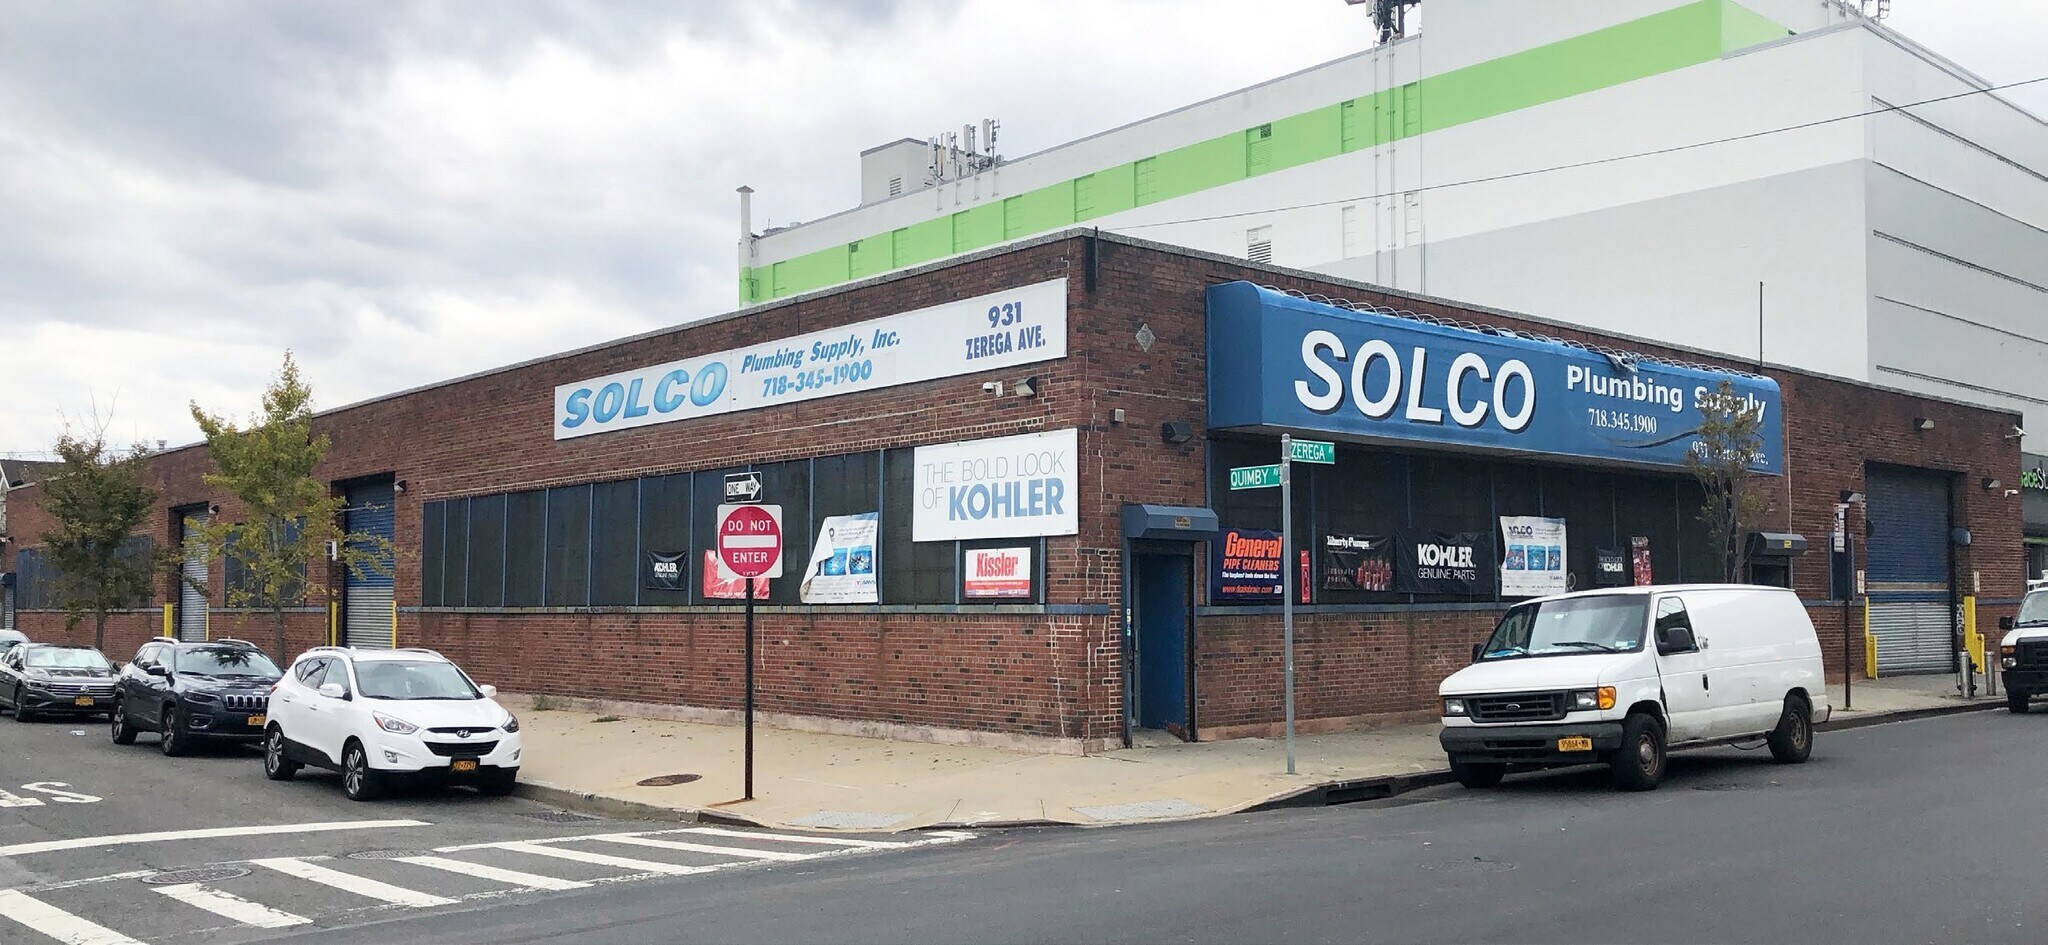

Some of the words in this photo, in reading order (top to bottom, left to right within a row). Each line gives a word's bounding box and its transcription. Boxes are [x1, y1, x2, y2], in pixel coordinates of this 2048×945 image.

[988, 301, 1023, 328] 931
[741, 347, 804, 374] Plumbing
[810, 334, 866, 363] Supply,
[871, 327, 901, 349] Inc.
[965, 332, 1015, 360] ZEREGA
[1018, 326, 1047, 351] AVE.
[763, 359, 873, 397] 718-345-1900
[1294, 329, 1536, 432] SOLCO
[1566, 364, 1684, 413] Plumbing
[561, 361, 729, 429] SOLCO
[1588, 408, 1658, 435] 718.345.1900
[1291, 443, 1326, 461] ZEREGA
[1692, 441, 1708, 458] 931
[923, 461, 955, 485] THE
[962, 456, 1009, 482] BOLD
[1017, 450, 1066, 477] LOOK
[1230, 469, 1269, 487] QUIMBY
[728, 483, 739, 494] ONE
[745, 481, 757, 493] WAY
[922, 487, 944, 510] OF
[949, 478, 1065, 521] KOHLER
[728, 520, 743, 532] DO
[750, 520, 772, 532] NOT
[732, 552, 768, 563] ENTER
[1225, 531, 1283, 558] General
[976, 553, 1019, 578] Kissler
[1223, 558, 1241, 570] PIPE
[1242, 559, 1280, 571] CLEANERS
[1417, 569, 1452, 579] GENUINE
[1453, 569, 1476, 580] PARTS
